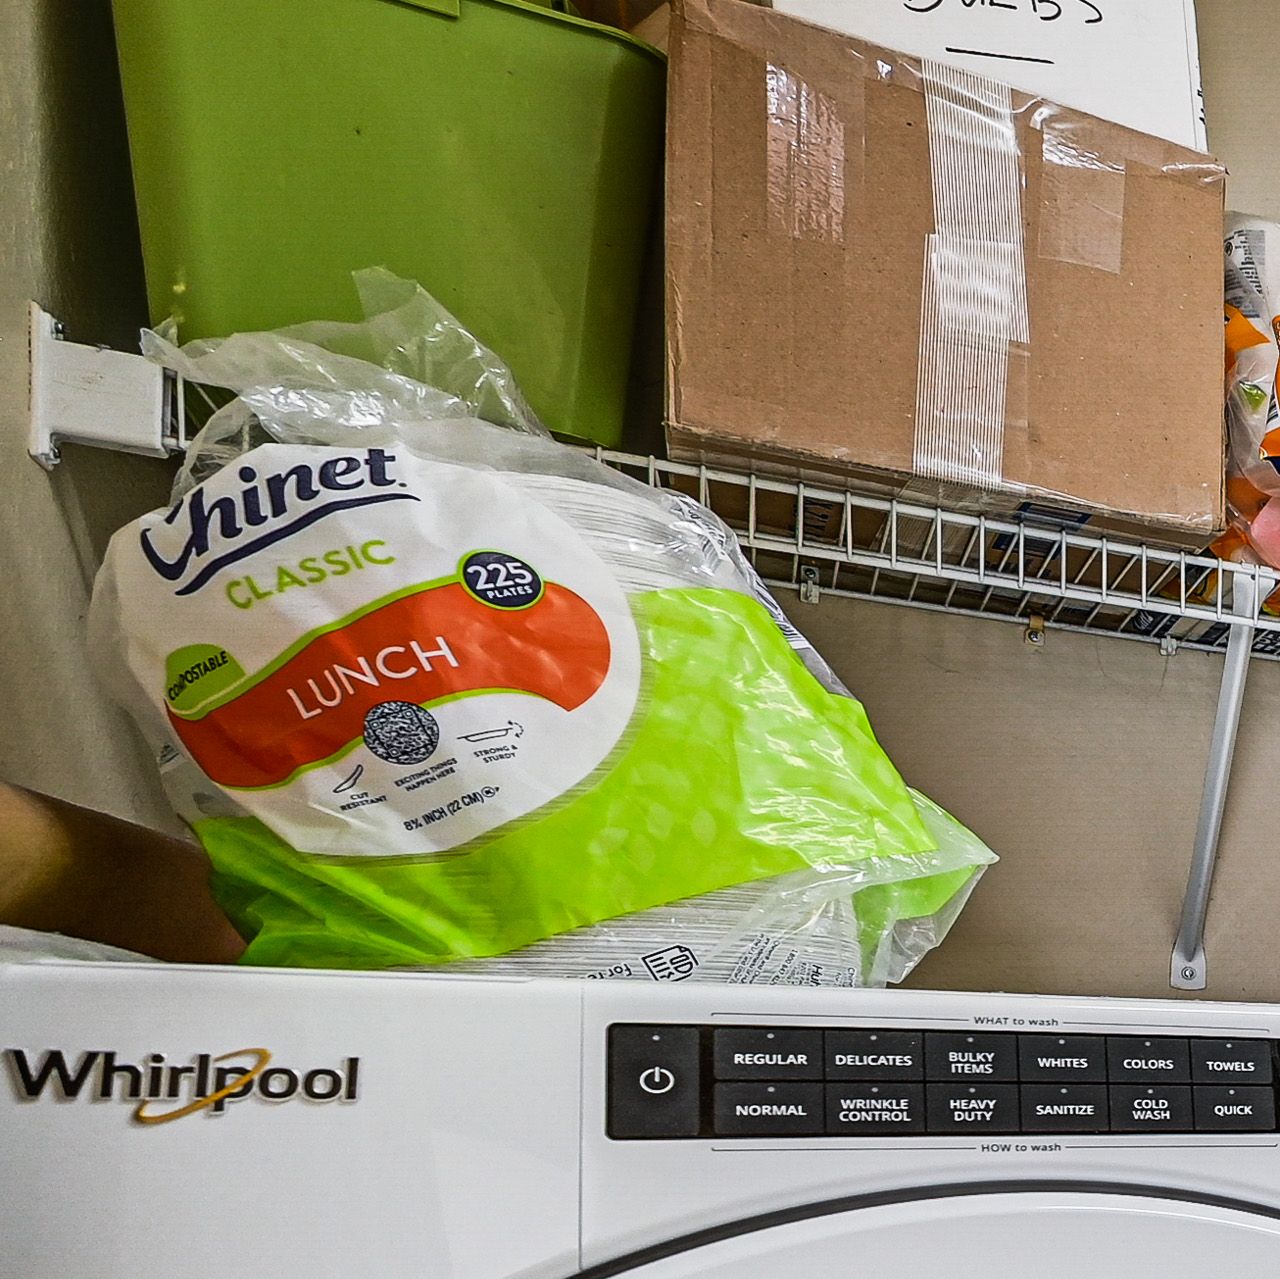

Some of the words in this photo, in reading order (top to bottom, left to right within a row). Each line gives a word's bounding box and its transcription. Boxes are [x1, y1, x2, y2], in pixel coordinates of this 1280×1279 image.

[140, 446, 408, 581] Chinet
[225, 538, 396, 610] CLASSIC
[465, 560, 534, 589] 225
[487, 584, 533, 600] PLATES
[286, 635, 459, 721] LUNCH
[473, 744, 511, 759] STRONG
[483, 752, 517, 764] STURDY
[394, 767, 431, 788] EXCITING
[431, 757, 458, 774] THINGS
[405, 776, 436, 792] HAPPEN
[436, 767, 456, 782] HERE
[350, 791, 369, 800] CUT
[340, 795, 388, 812] RESISTANT
[424, 808, 447, 826] INCH
[447, 799, 461, 820] (22
[461, 790, 484, 809] CM)
[973, 1016, 1009, 1025] WHAT
[1012, 1017, 1025, 1026] to
[1027, 1017, 1059, 1027] wash
[733, 1053, 808, 1066] REGULAR
[835, 1054, 913, 1067] DELICATES
[948, 1051, 995, 1063] BULKY
[1037, 1057, 1089, 1069] WHITES
[951, 1063, 994, 1075] ITEMS
[1122, 1058, 1174, 1070] COLORS
[1206, 1060, 1255, 1072] TOWELS
[5, 1047, 360, 1124] Whirlpool
[840, 1098, 909, 1110] WRINKLE
[949, 1098, 997, 1110] HEAVY
[1035, 1104, 1095, 1116] SANITIZE
[1133, 1099, 1169, 1110] COLD
[735, 1104, 807, 1117] NORMAL
[838, 1110, 912, 1122] CONTROL
[953, 1110, 993, 1122] DUTY
[1132, 1109, 1171, 1121] WASH
[1214, 1104, 1253, 1117] QUICK
[980, 1142, 1012, 1153] HOW
[1014, 1142, 1028, 1153] to
[1029, 1142, 1062, 1153] wash
